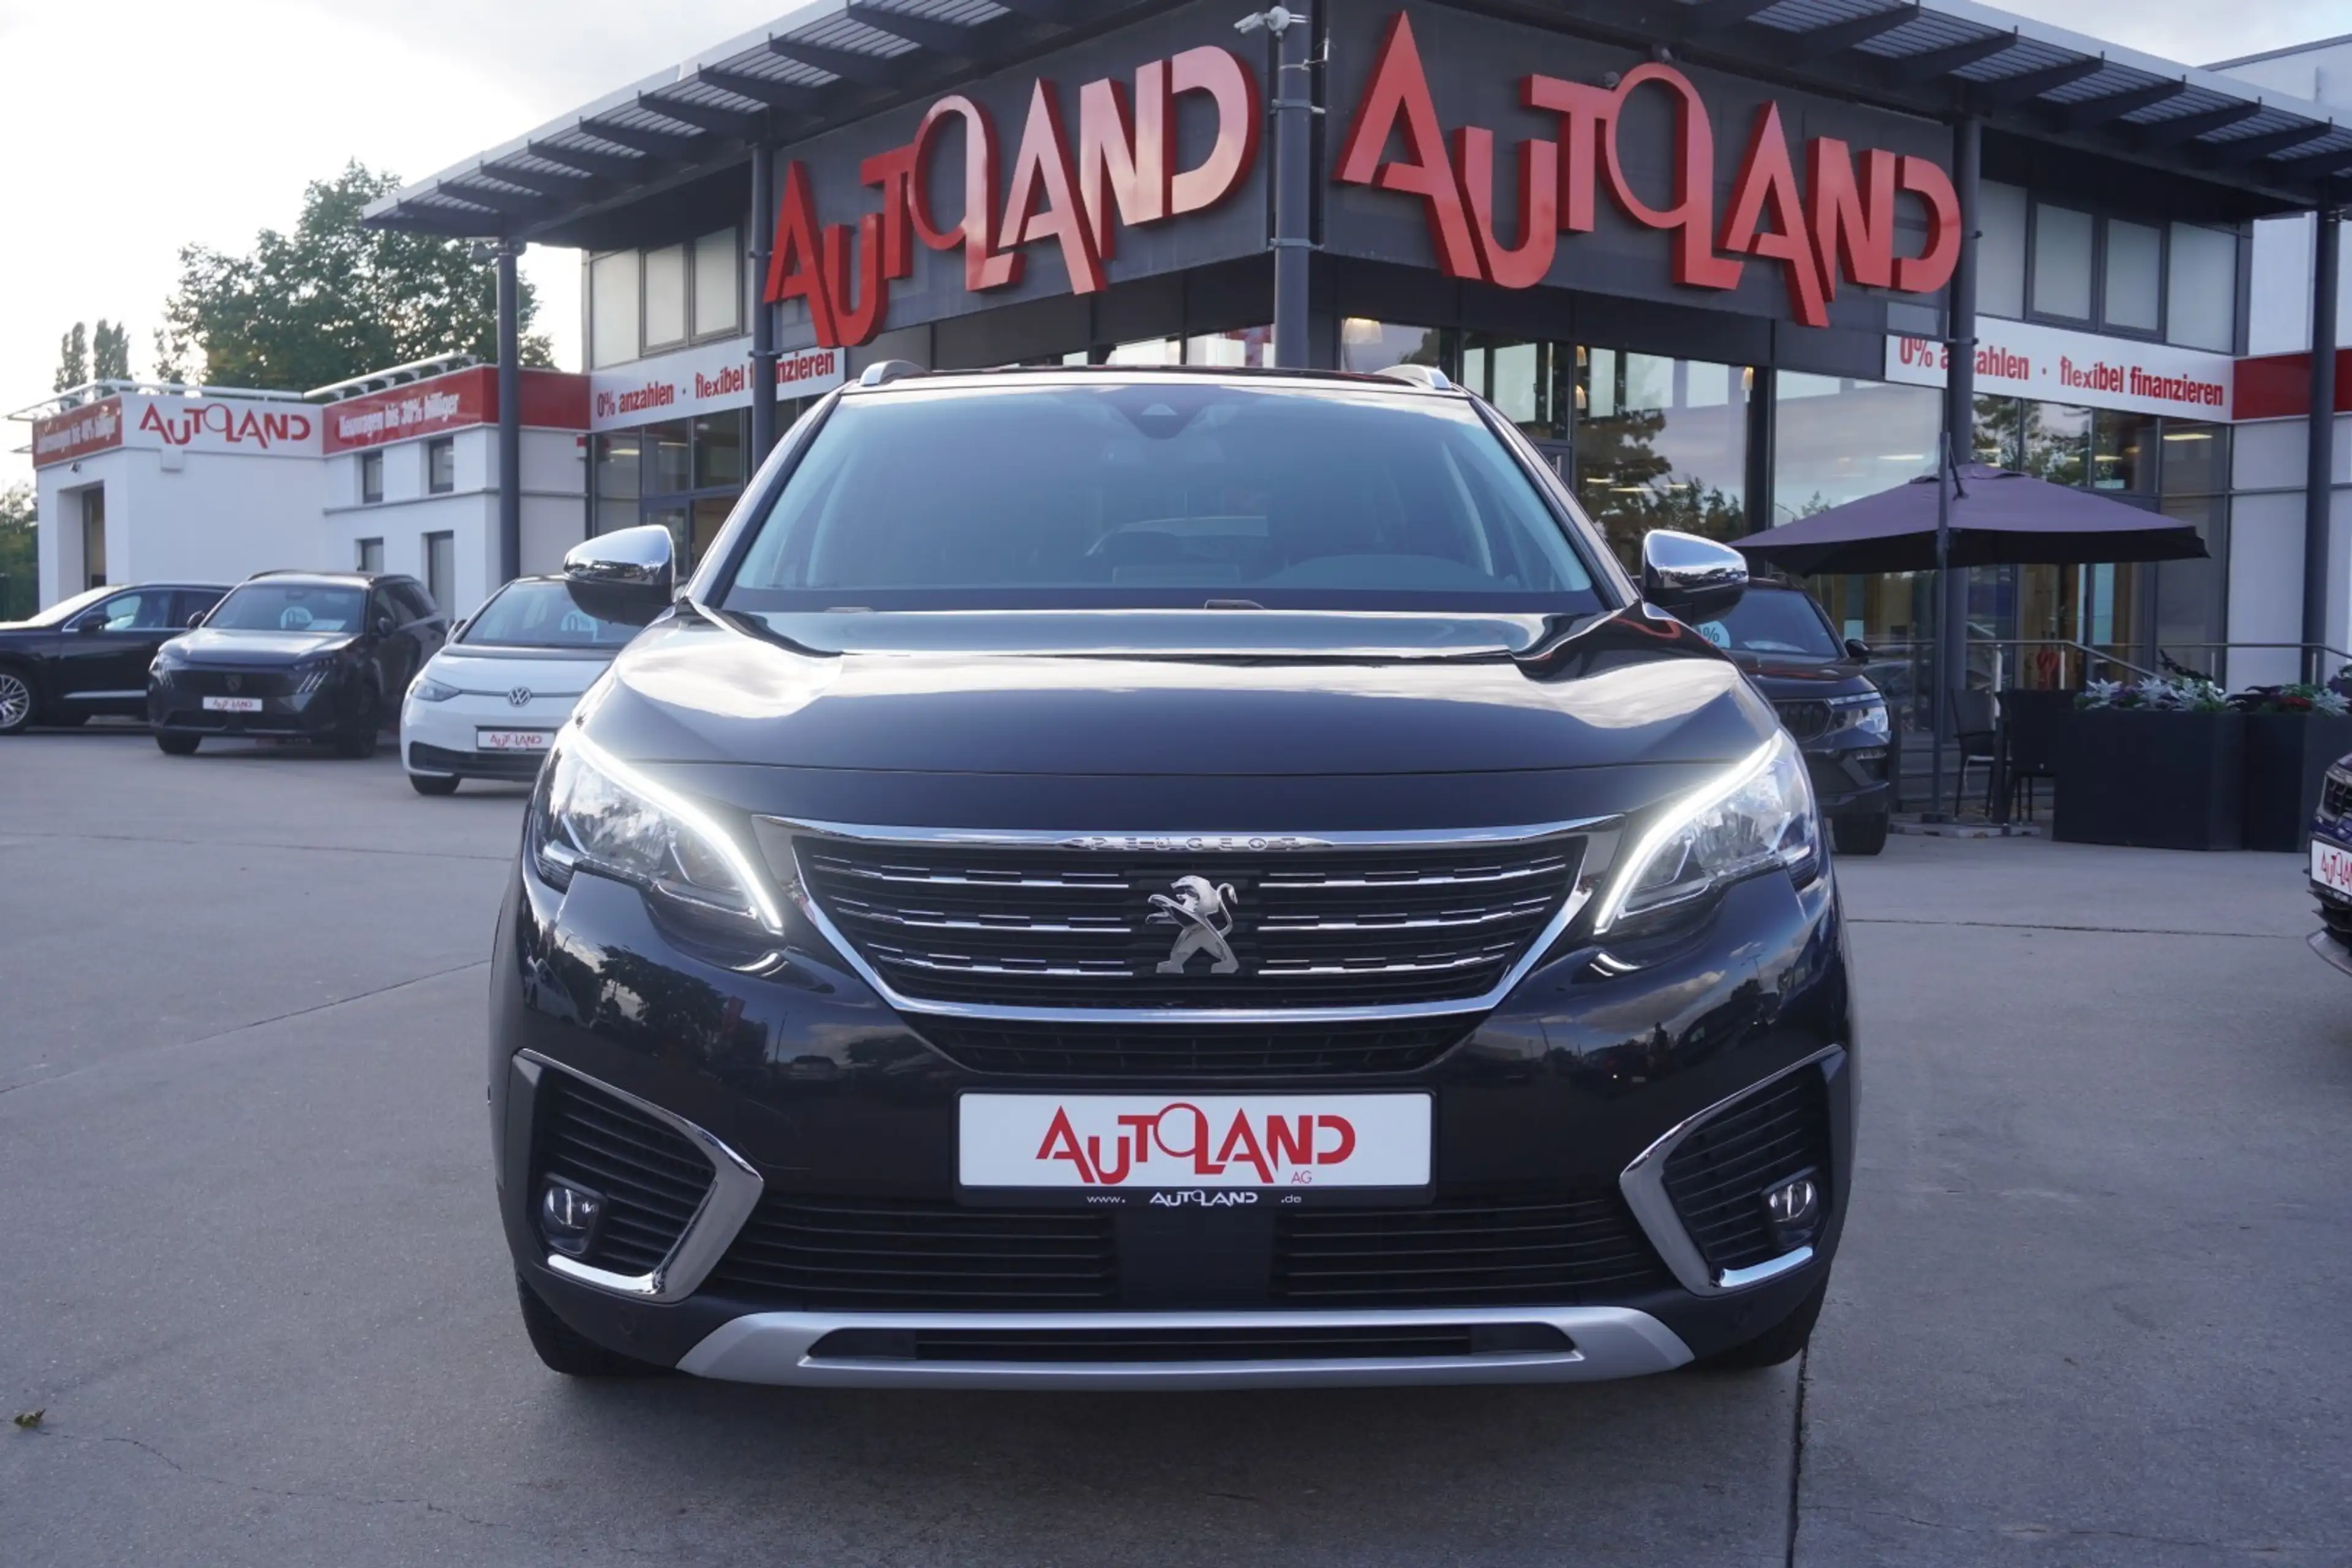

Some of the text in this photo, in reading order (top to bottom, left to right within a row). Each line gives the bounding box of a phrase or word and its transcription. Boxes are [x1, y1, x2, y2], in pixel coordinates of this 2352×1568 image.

[763, 45, 1259, 349] AUTOLAND
[1335, 10, 1961, 327] AUTOLAND
[597, 351, 835, 418] 0% anzahlen flexibel fnzieren
[1900, 336, 2224, 406] 0% aahlen flexibel finanzieren
[139, 402, 311, 449] AUTOLAND
[1091, 837, 1297, 851] PEUGEOT
[1035, 1102, 1356, 1185] AUTOLAND
[1291, 1170, 1313, 1184] AG
[1087, 1189, 1302, 1207] www. AUTOLAND .de
